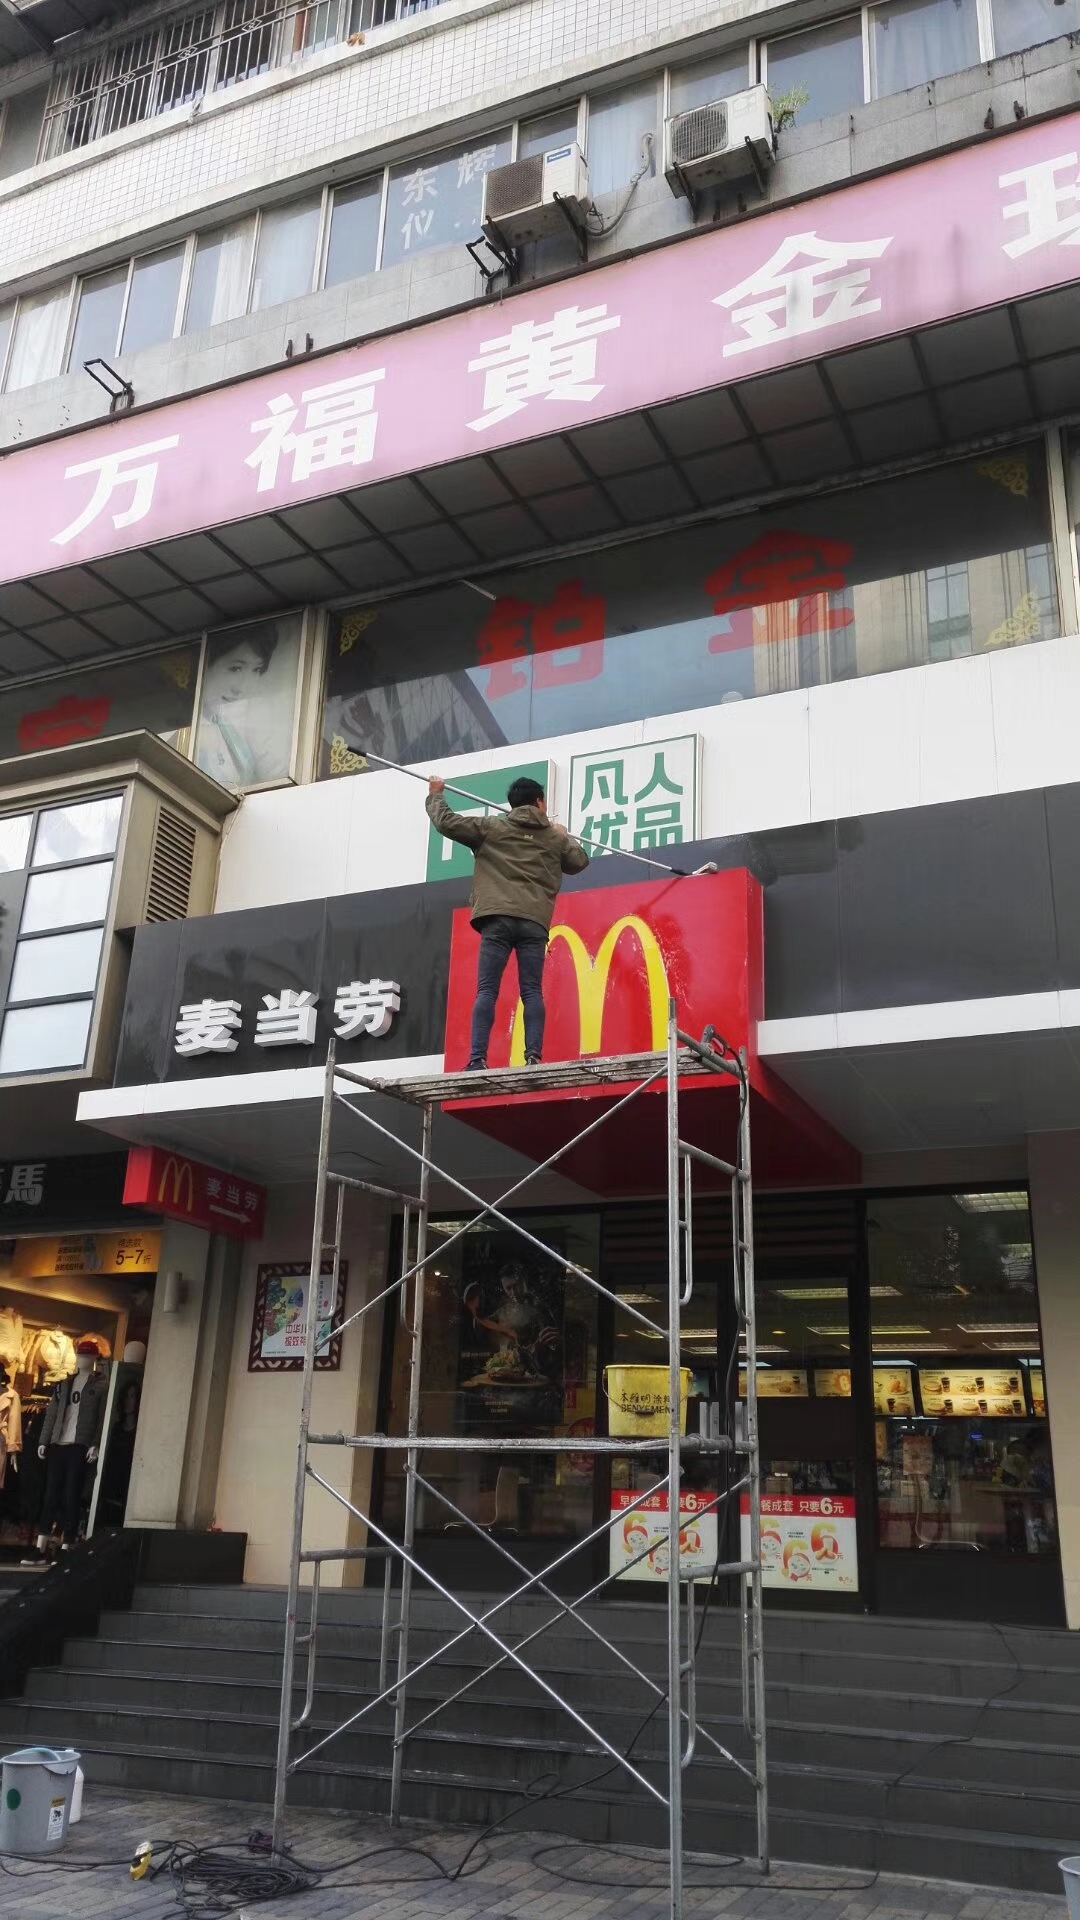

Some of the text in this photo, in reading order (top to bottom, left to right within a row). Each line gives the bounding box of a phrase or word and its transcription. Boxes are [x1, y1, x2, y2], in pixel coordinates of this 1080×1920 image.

[581, 751, 684, 812] 凡人
[580, 801, 684, 858] 优品
[174, 978, 401, 1057] 麦当劳
[0, 1162, 47, 1205] 馬
[207, 1177, 258, 1211] 麦当劳
[285, 1323, 307, 1334] 中华儿
[760, 1497, 845, 1515] 餐成套 只要6元
